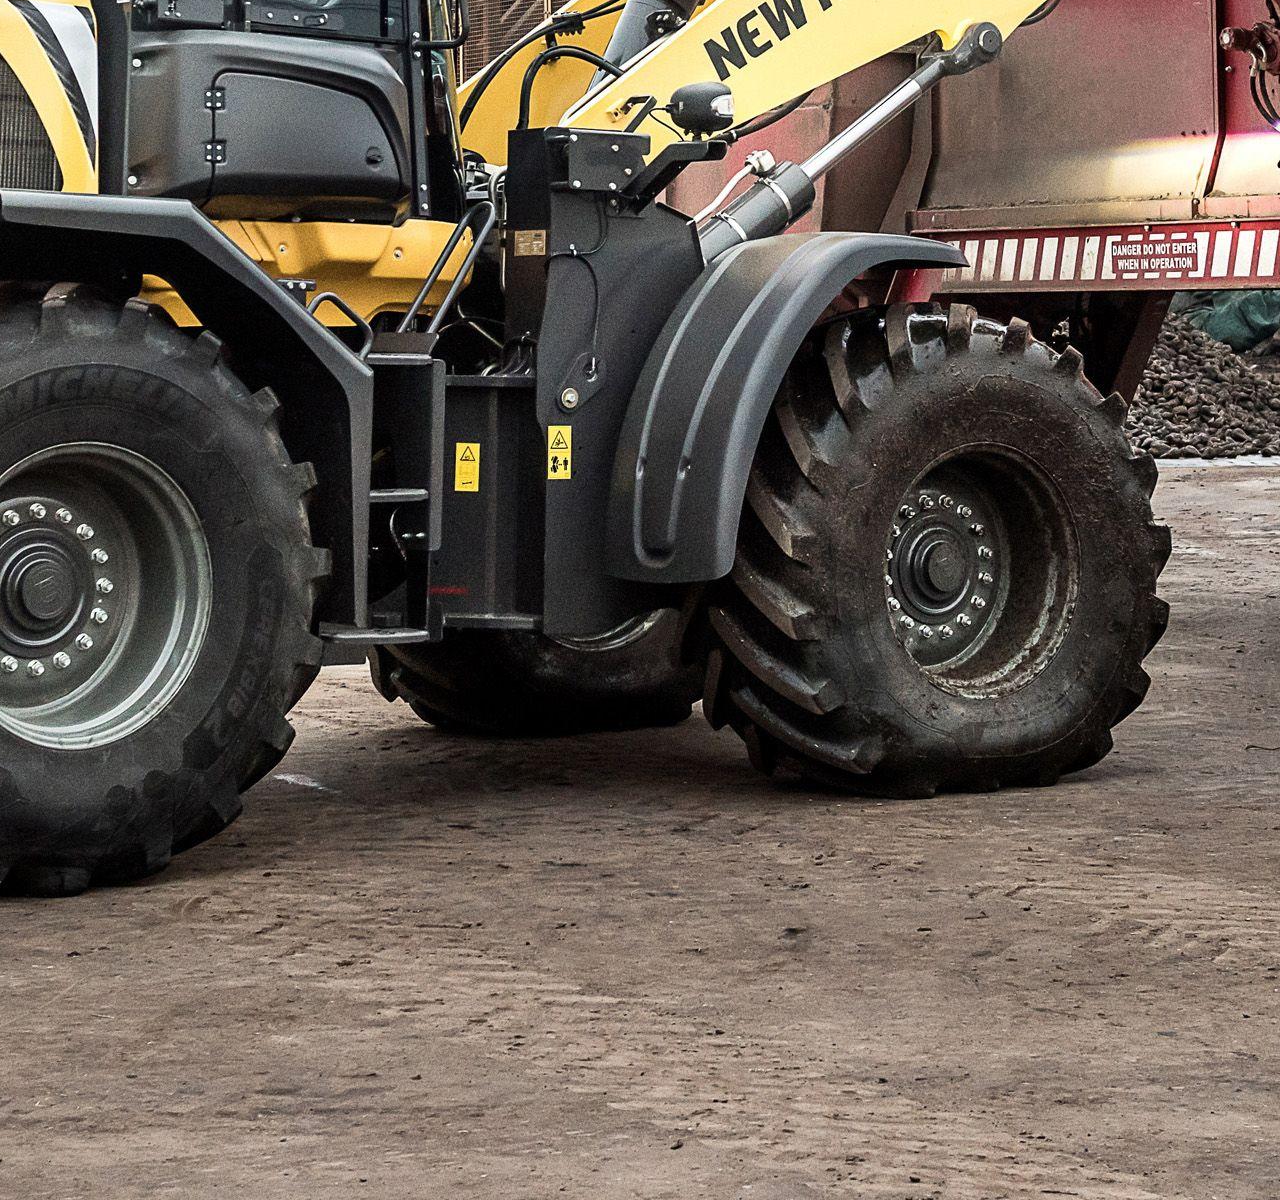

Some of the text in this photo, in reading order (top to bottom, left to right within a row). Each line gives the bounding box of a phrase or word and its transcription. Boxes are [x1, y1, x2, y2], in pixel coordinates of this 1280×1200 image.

[1112, 242, 1197, 256] DANGER DO NOT ENTER
[1118, 257, 1193, 270] WHEN IN OPERATION
